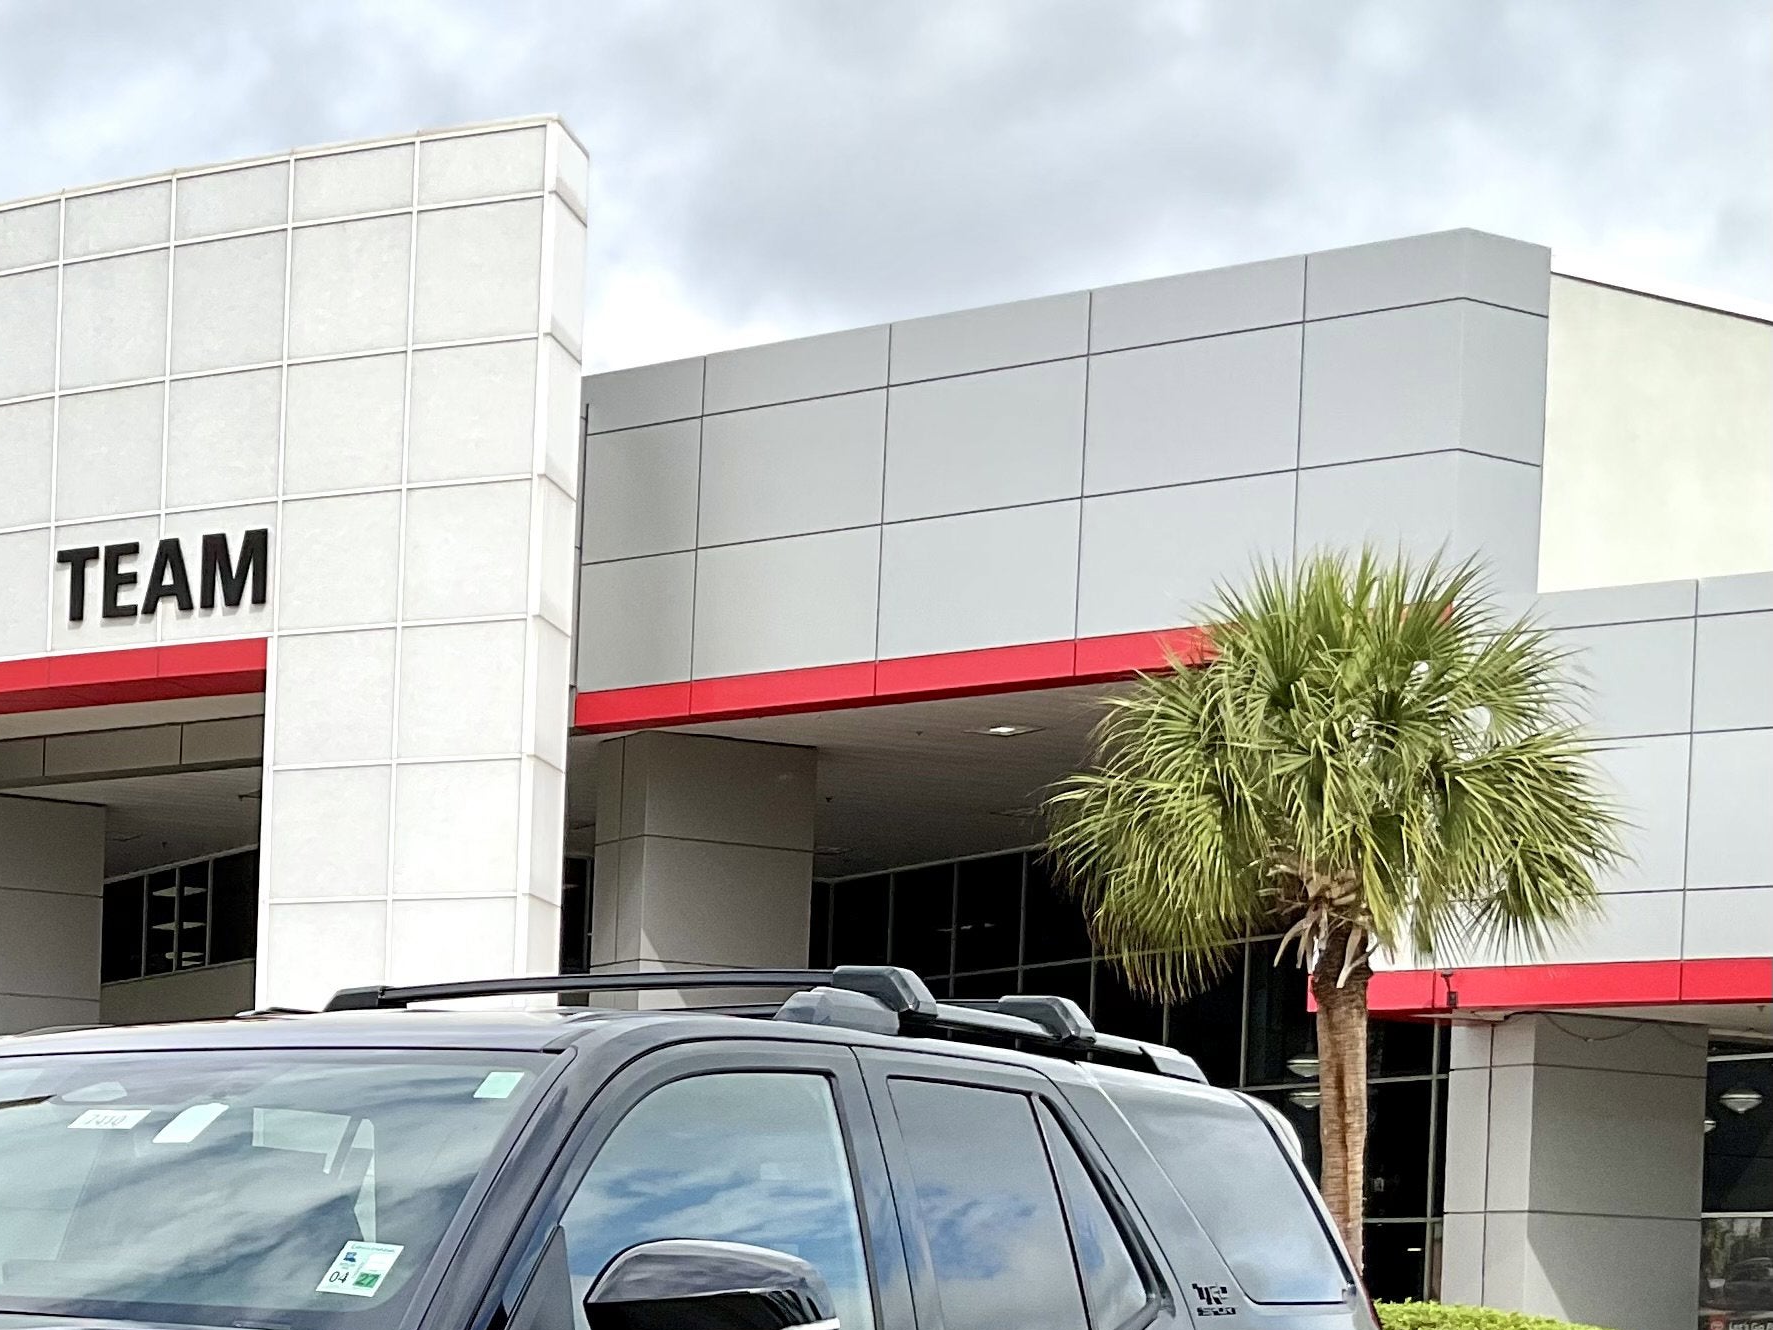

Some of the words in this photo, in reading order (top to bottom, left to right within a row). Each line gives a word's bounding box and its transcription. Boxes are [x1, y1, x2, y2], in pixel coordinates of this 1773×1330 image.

[57, 529, 268, 621] TEAM
[329, 1271, 350, 1283] 04
[353, 1273, 381, 1288] 27
